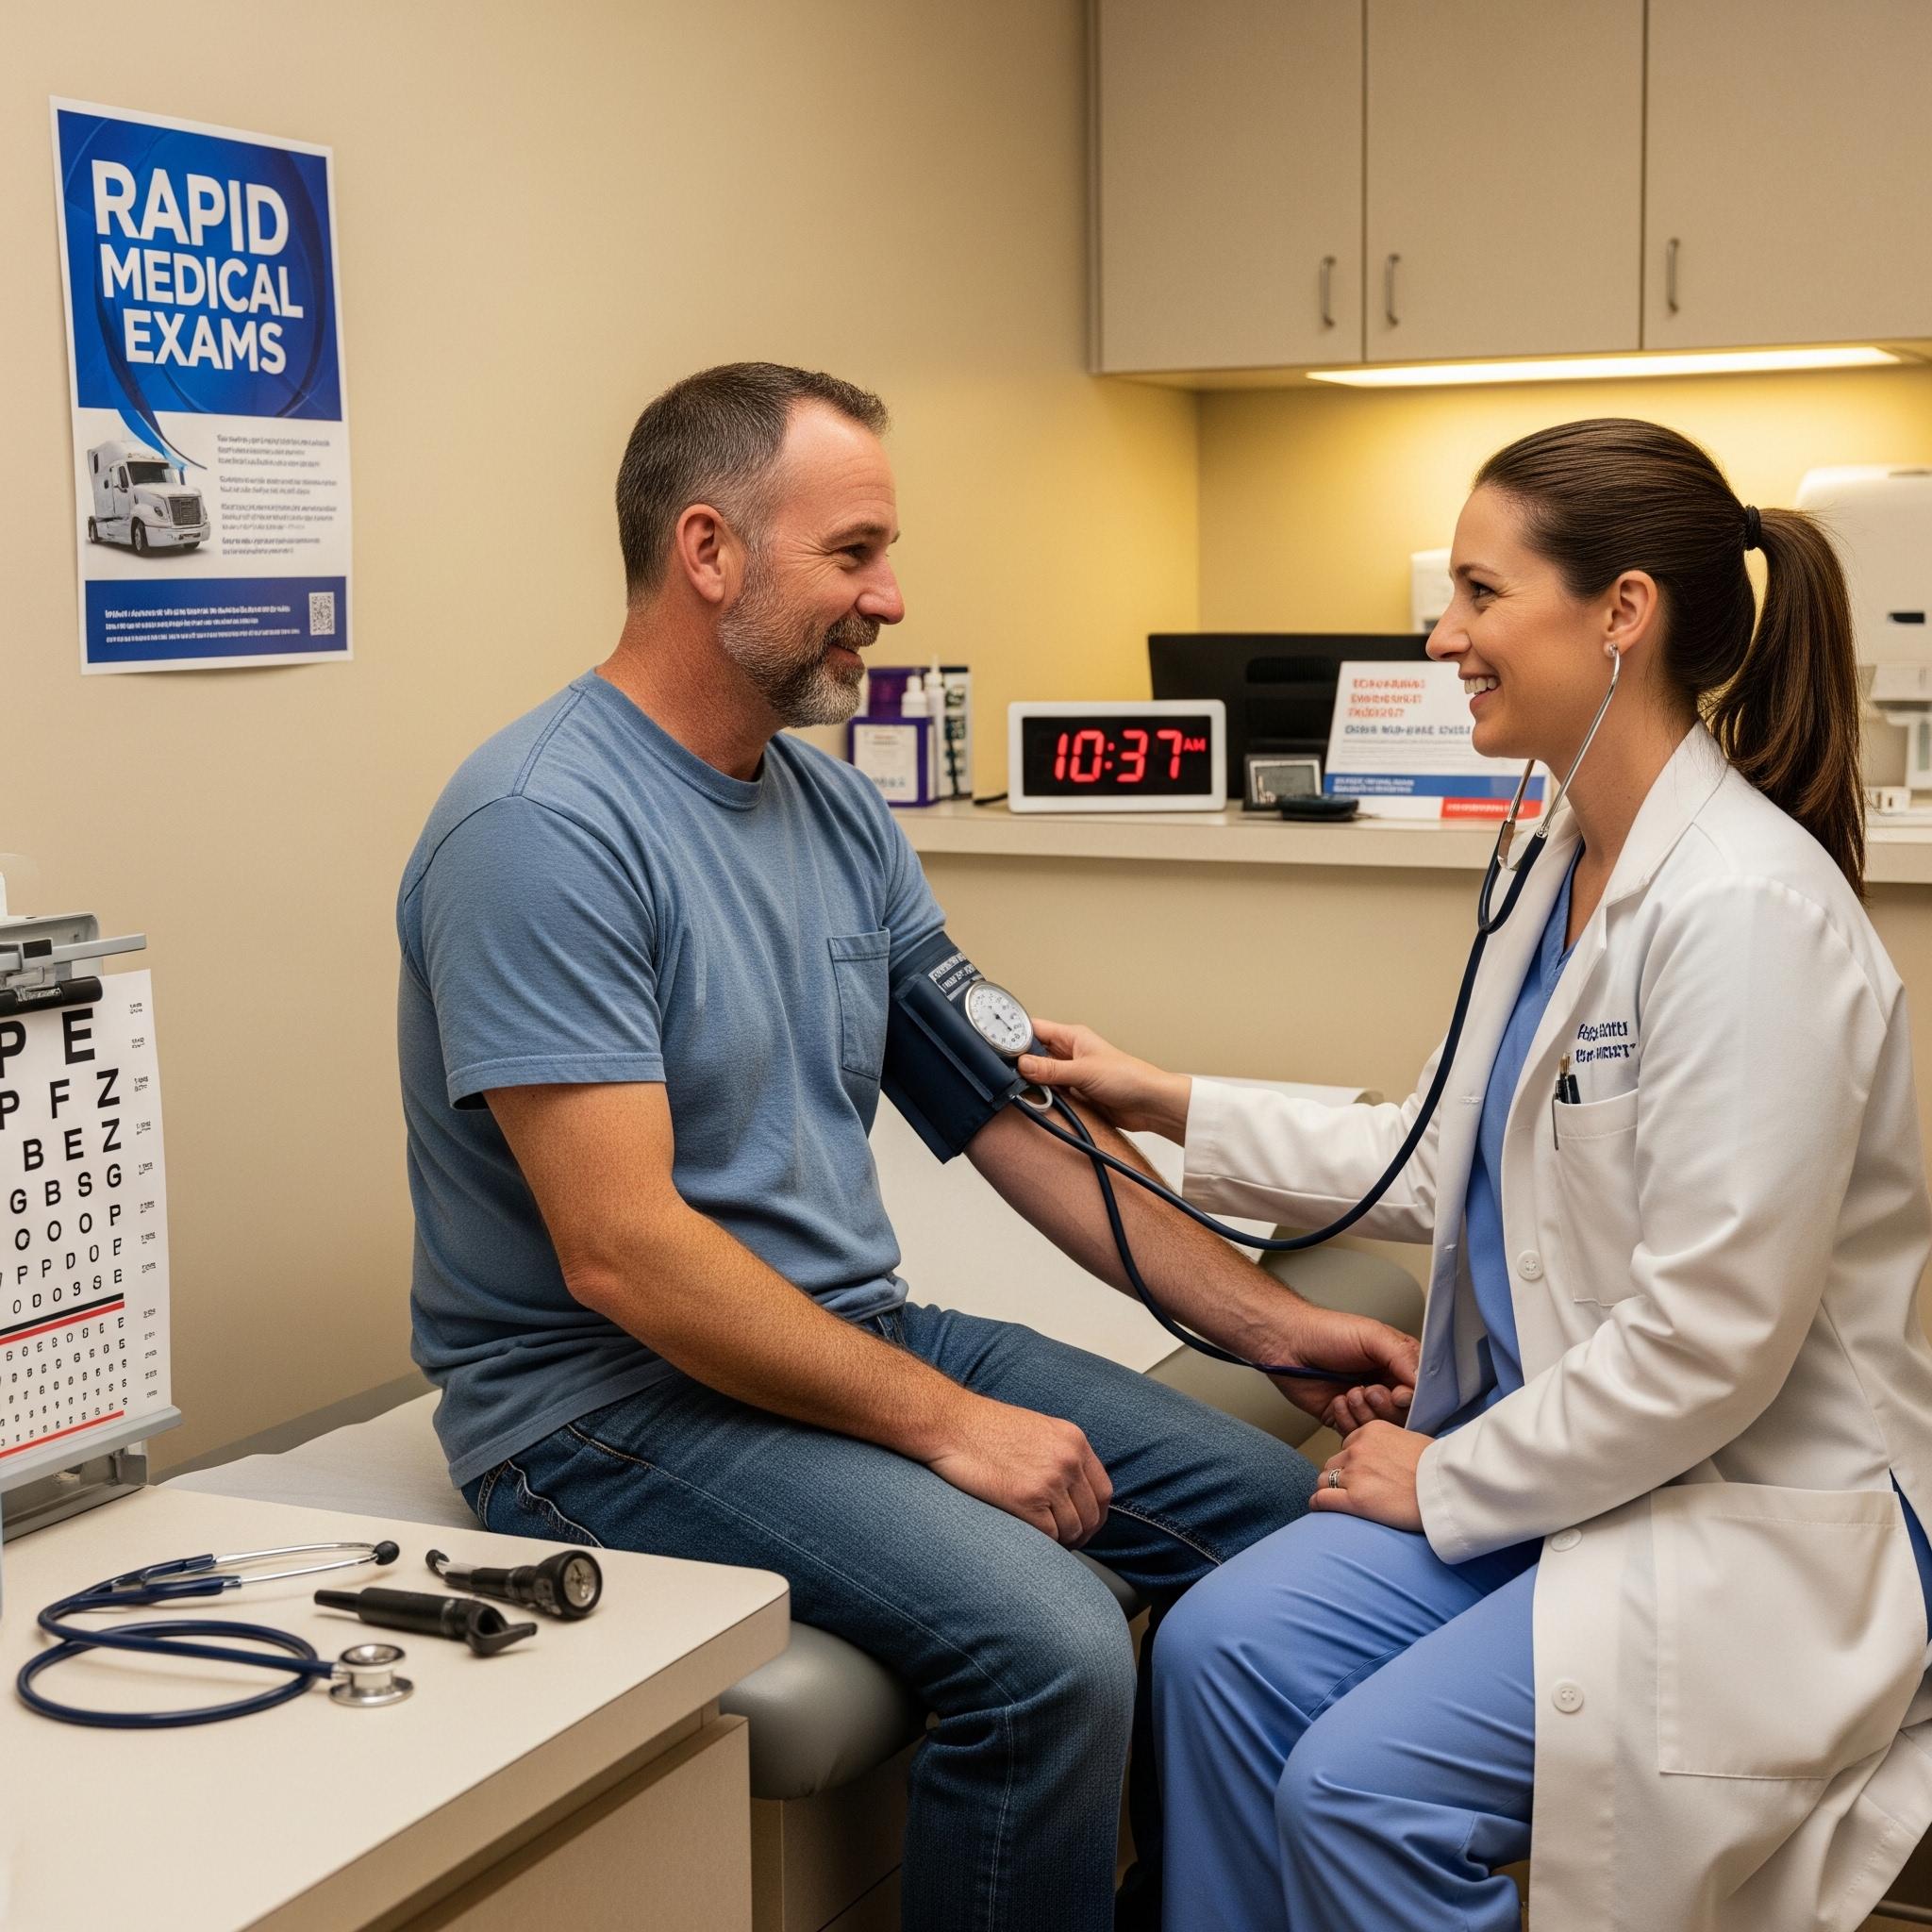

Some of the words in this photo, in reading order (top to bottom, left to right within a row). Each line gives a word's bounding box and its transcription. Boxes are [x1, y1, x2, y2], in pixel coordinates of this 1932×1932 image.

[92, 159, 289, 256] RAPID
[100, 243, 304, 319] MEDICAL
[123, 308, 287, 375] EXAMS
[1055, 730, 1182, 782] 10:37
[1183, 738, 1207, 752] AM
